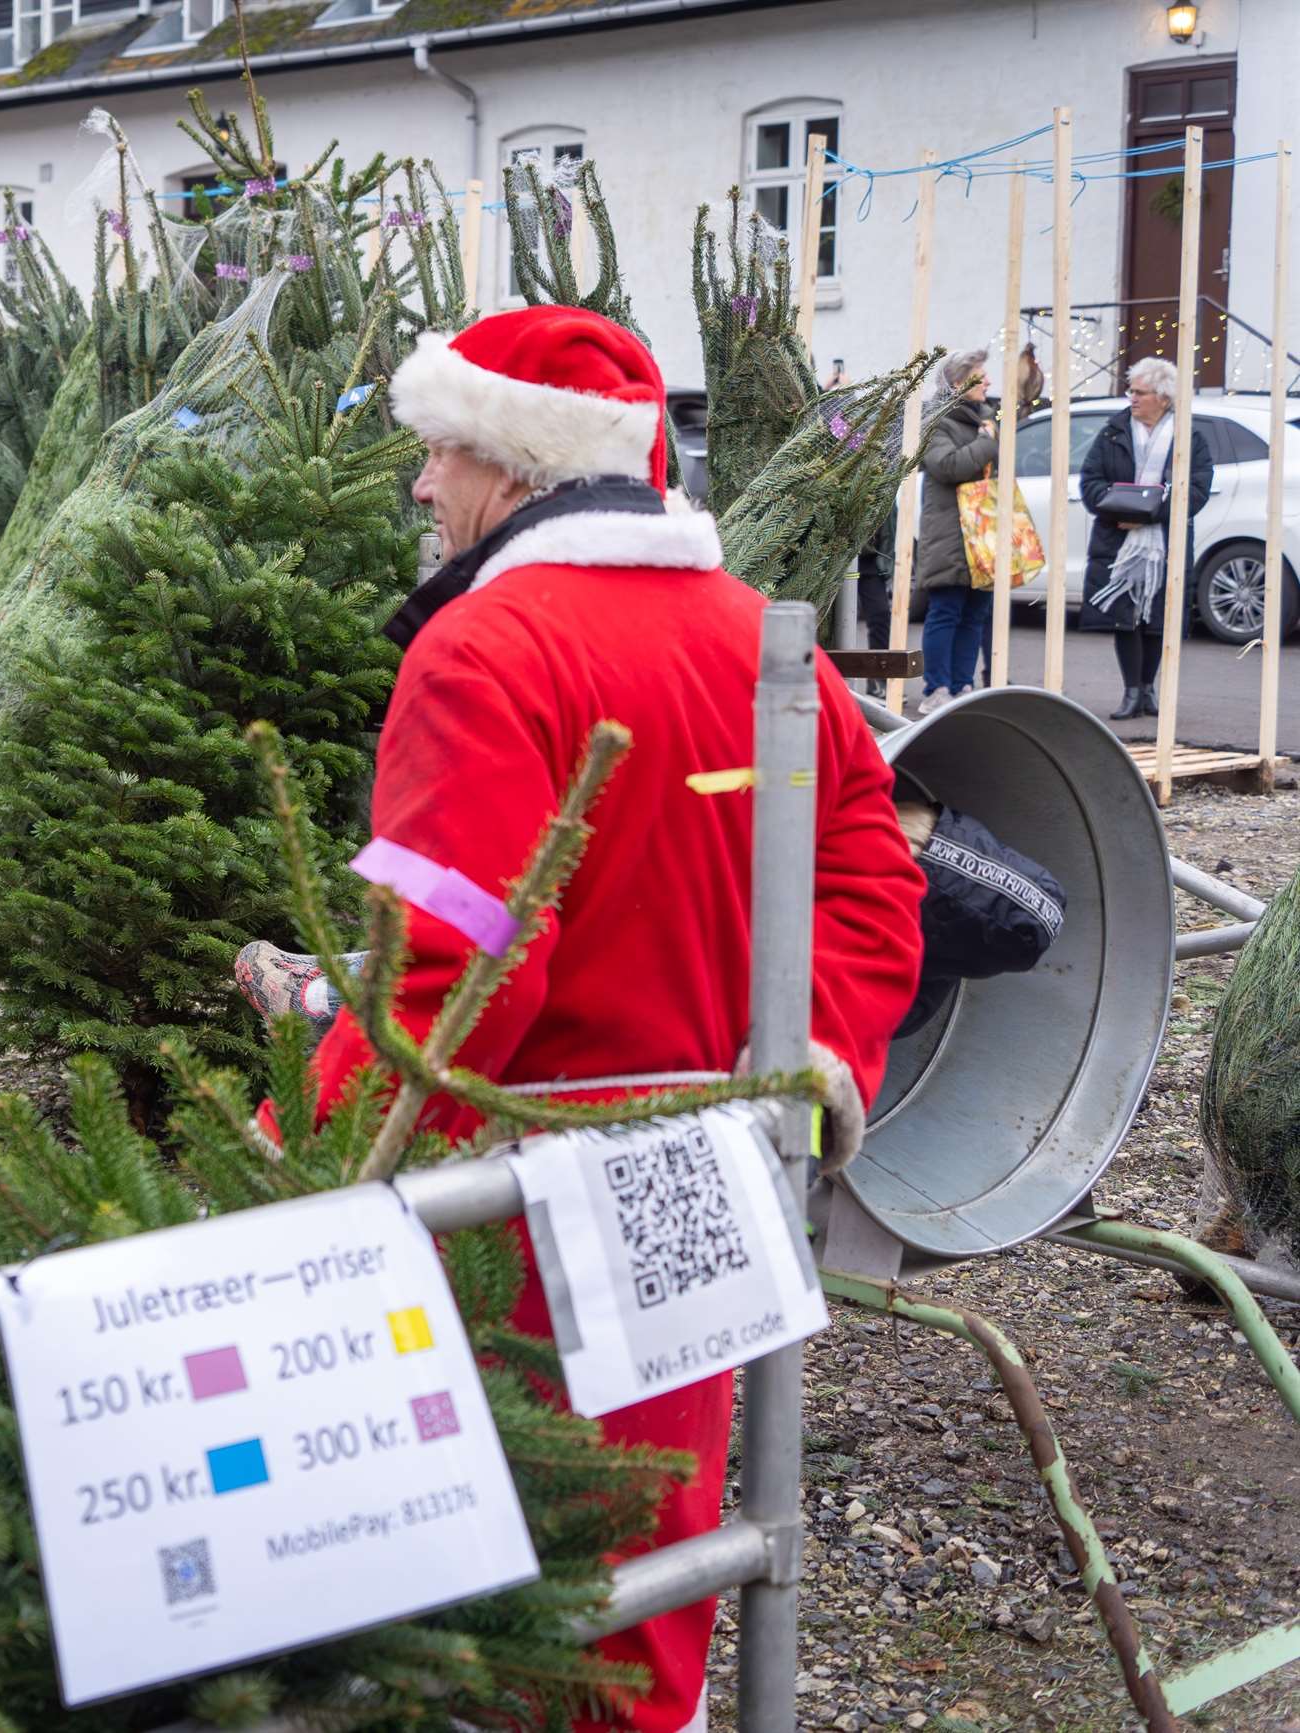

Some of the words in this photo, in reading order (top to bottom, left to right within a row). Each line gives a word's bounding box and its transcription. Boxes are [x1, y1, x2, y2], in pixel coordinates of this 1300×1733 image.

[929, 840, 961, 864] MOVE
[960, 853, 975, 871] TO
[975, 862, 1006, 885] YOUR
[1004, 875, 1041, 909] FUTURE
[270, 1332, 337, 1380] 200
[341, 1325, 375, 1363] kr
[637, 1343, 700, 1386] Wi-Fi
[704, 1329, 736, 1361] QR
[740, 1309, 784, 1344] code
[55, 1373, 130, 1426] 150
[136, 1366, 183, 1407] kr.
[293, 1421, 361, 1470] 300
[364, 1413, 408, 1451] kr.
[76, 1472, 153, 1526] 250
[161, 1463, 207, 1504] kr.
